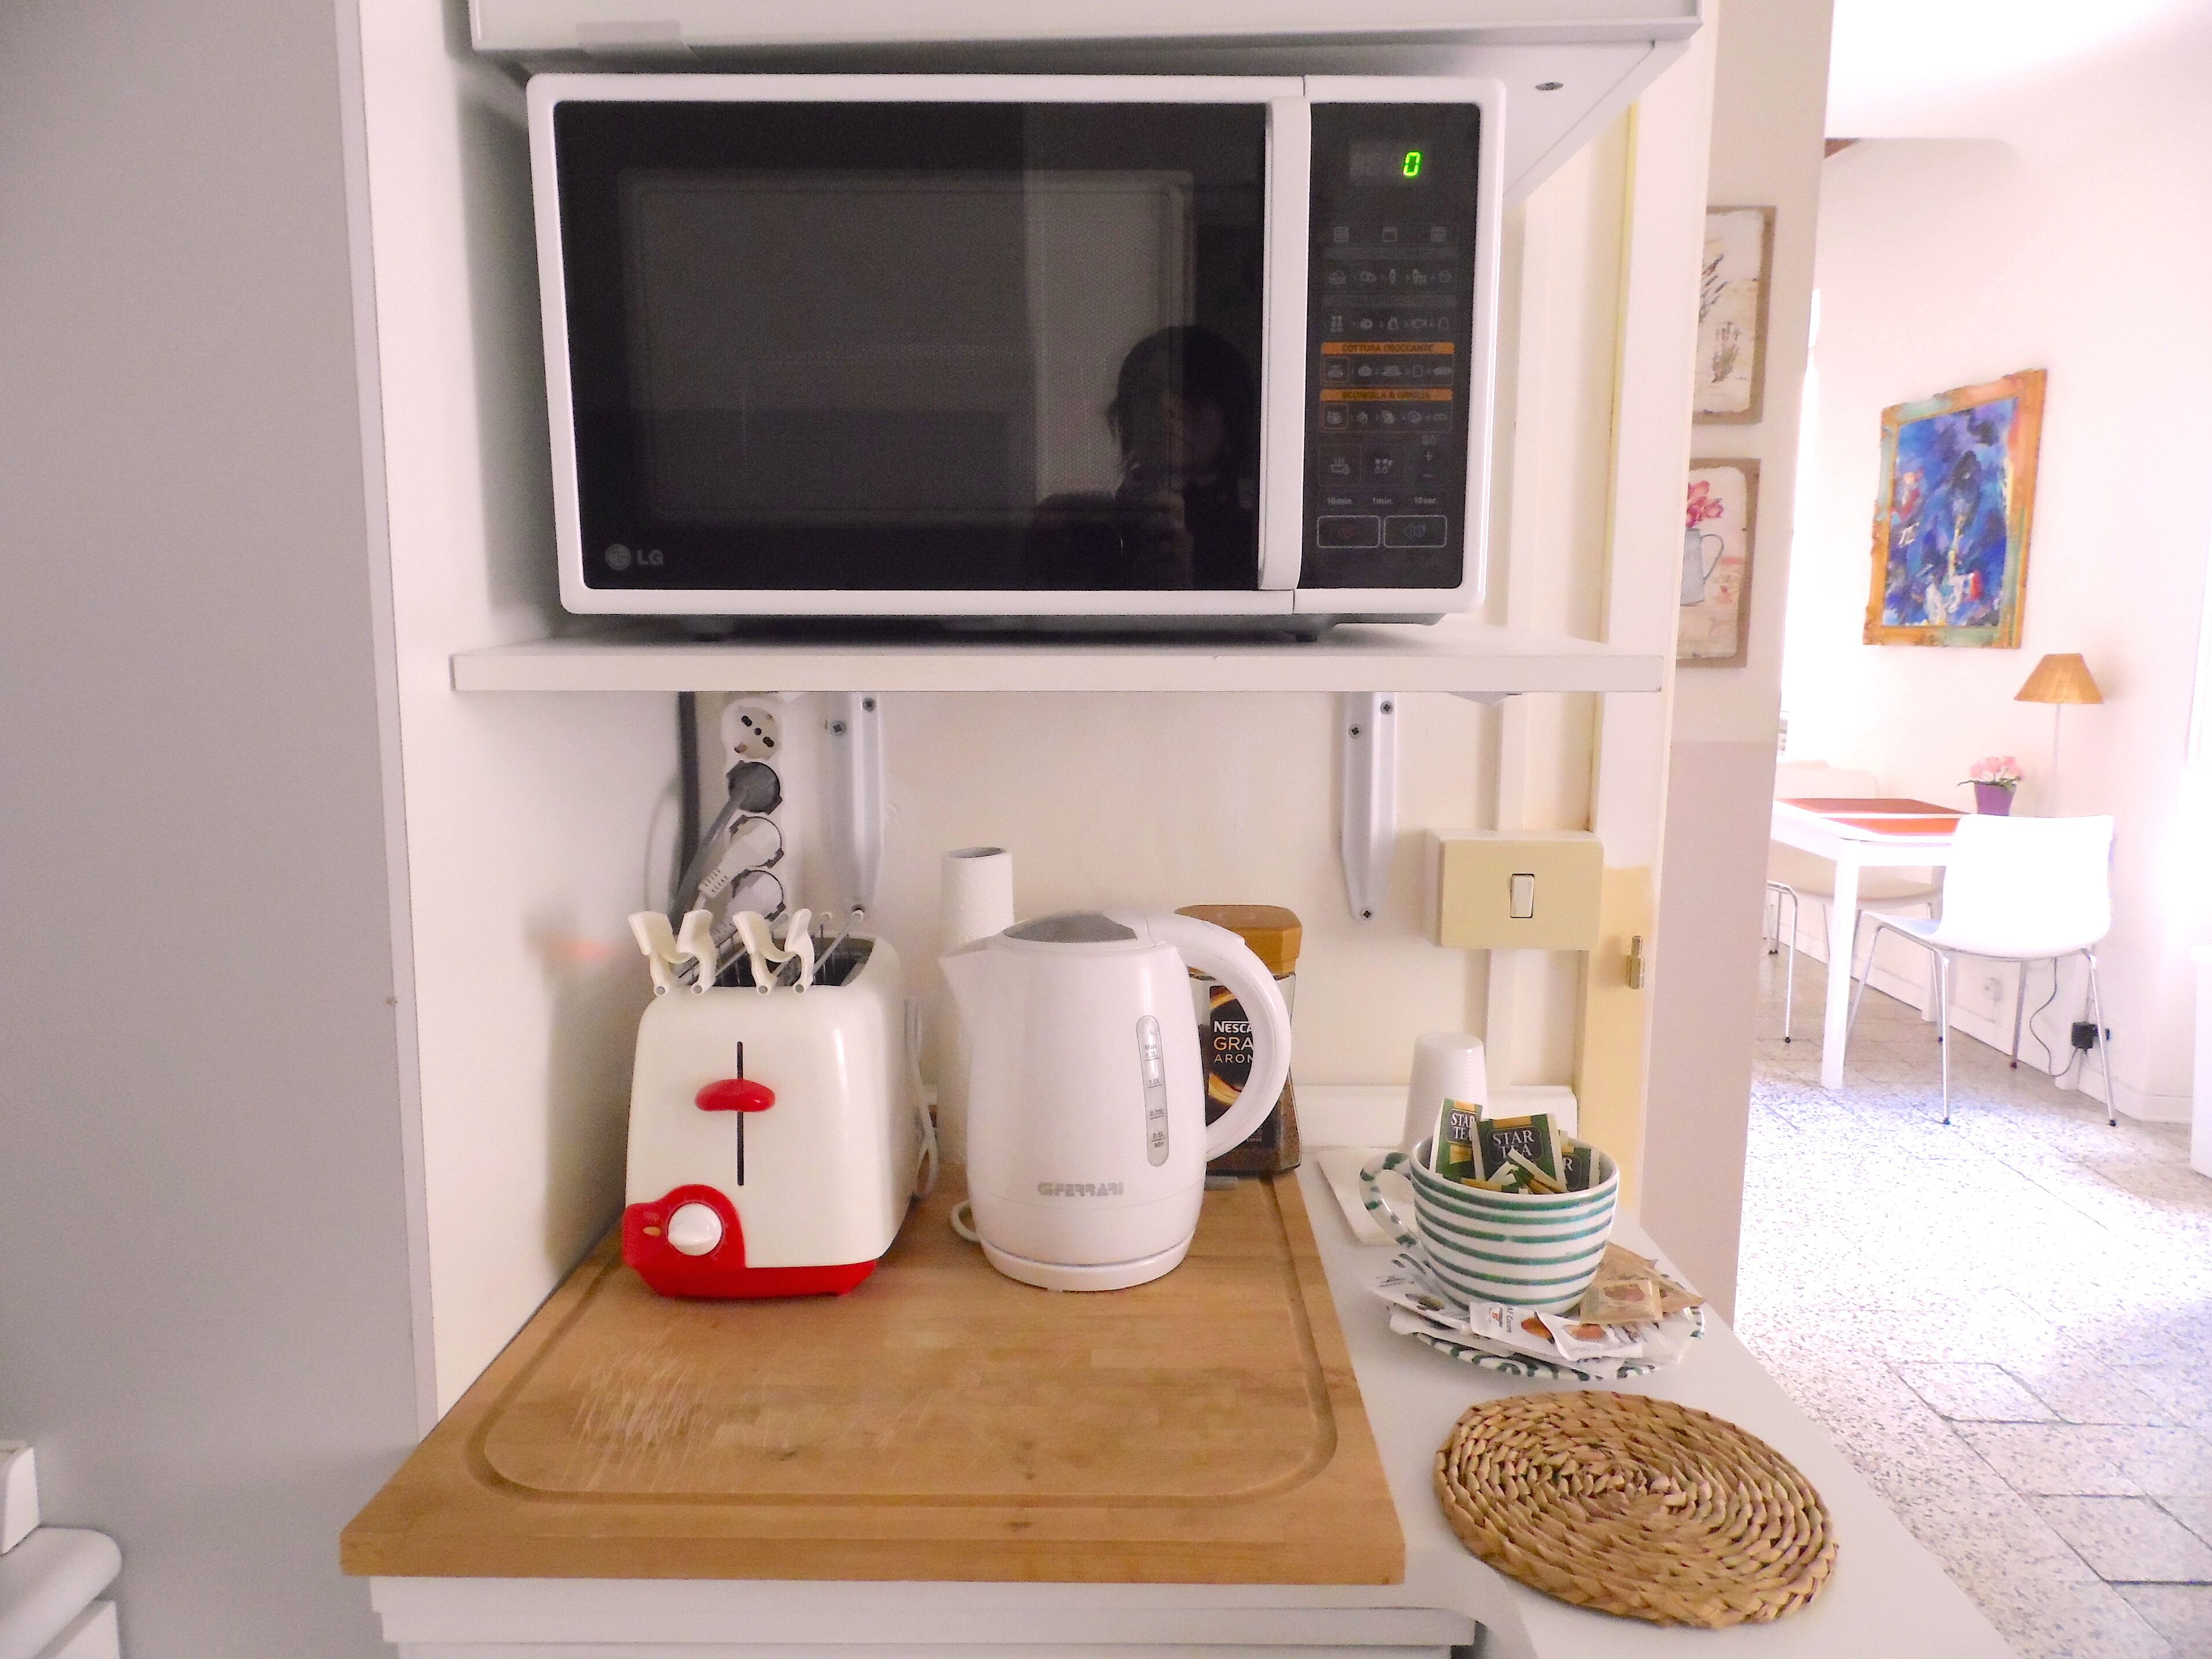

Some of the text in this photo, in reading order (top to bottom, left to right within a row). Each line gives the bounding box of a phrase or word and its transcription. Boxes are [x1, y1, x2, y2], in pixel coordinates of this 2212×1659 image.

[1402, 150, 1423, 177] 0
[1341, 344, 1381, 352] COTTURA
[637, 549, 664, 565] LG
[1493, 1130, 1535, 1145] STAR
